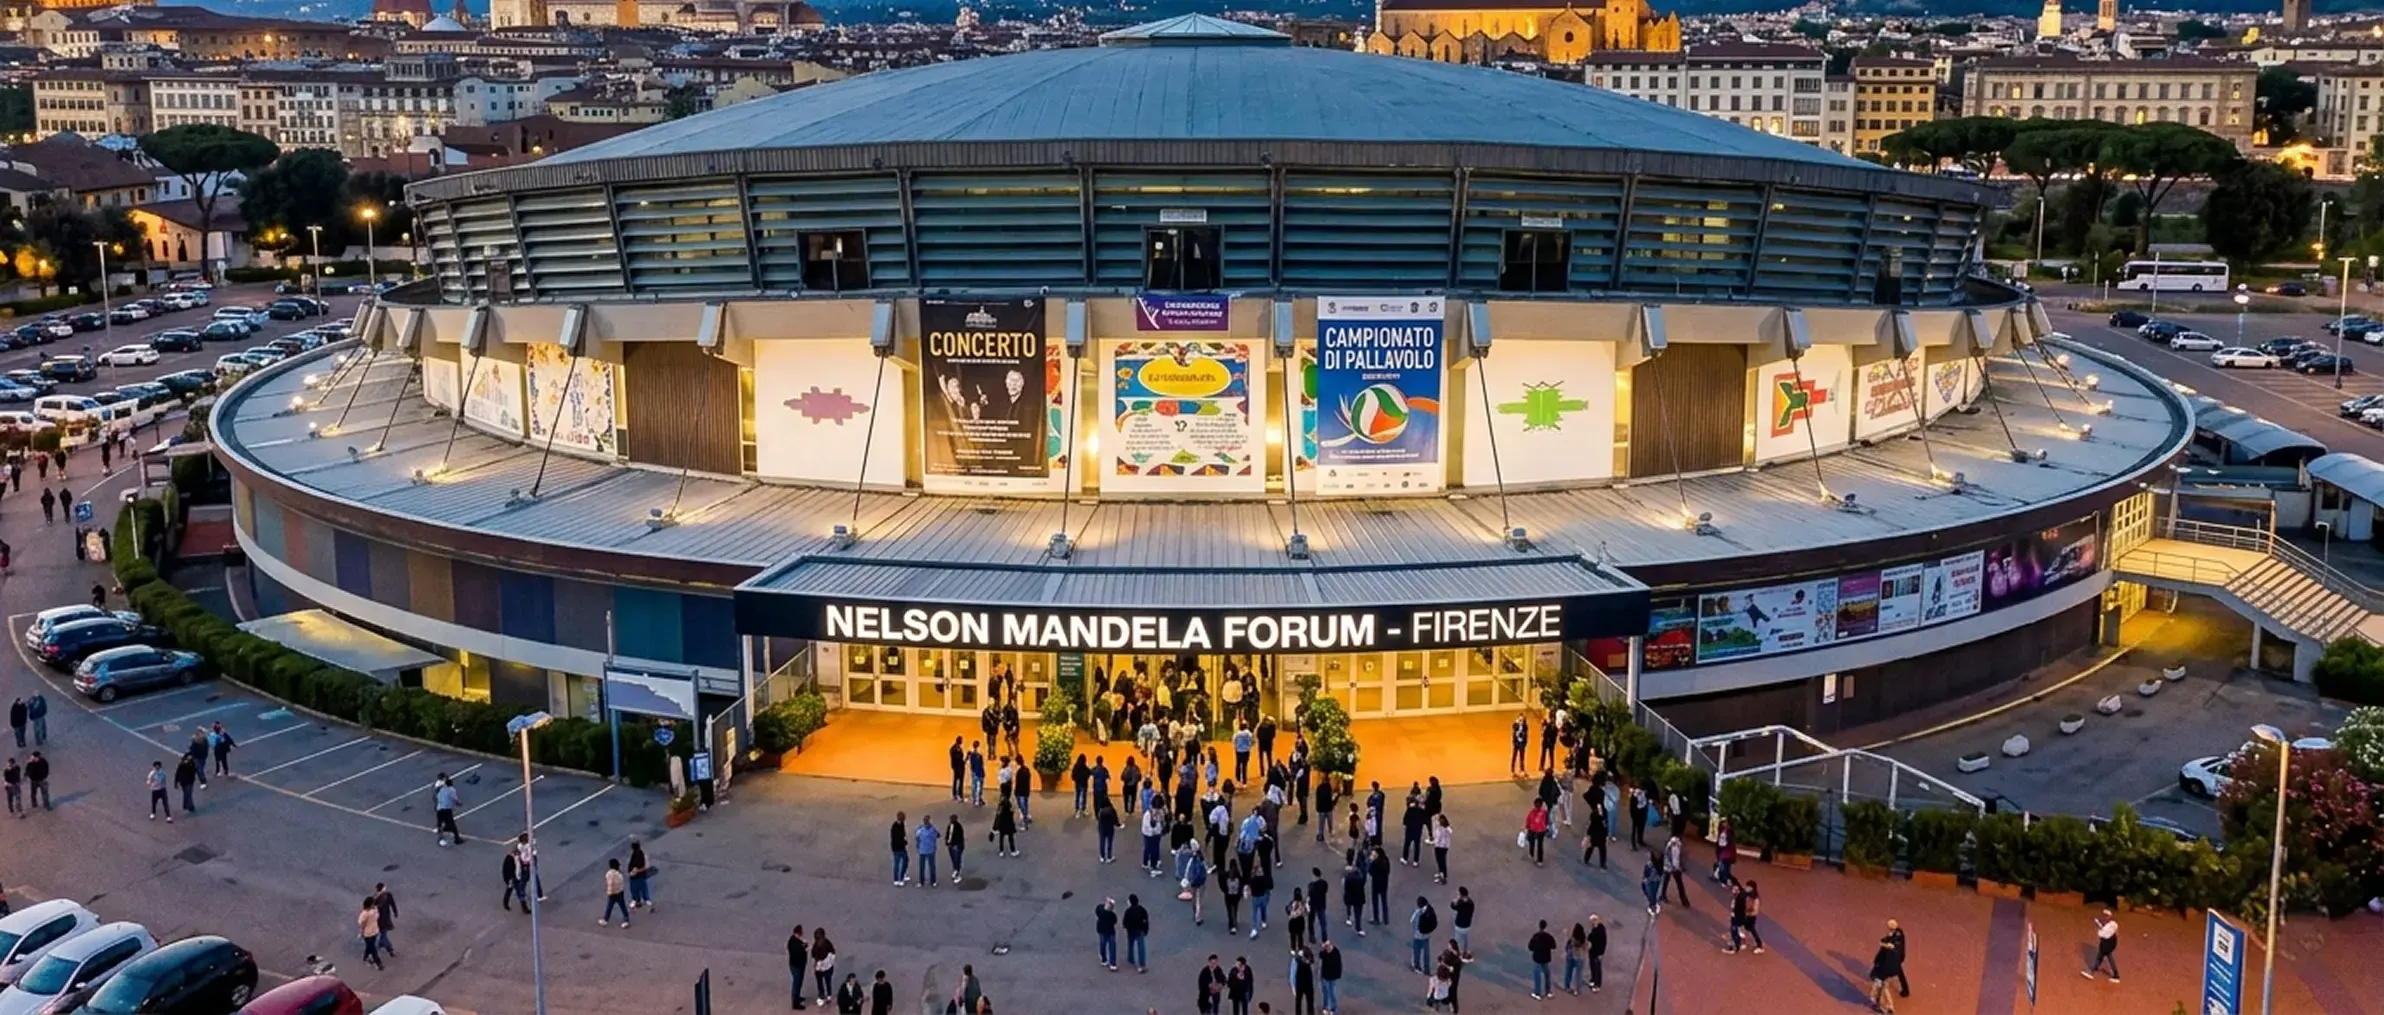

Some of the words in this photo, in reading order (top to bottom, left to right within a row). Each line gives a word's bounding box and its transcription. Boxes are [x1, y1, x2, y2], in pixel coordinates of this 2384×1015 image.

[930, 332, 1036, 358] CONCERTO
[1325, 326, 1434, 348] CAMPIONATO
[1324, 350, 1341, 370] DI
[1345, 349, 1434, 370] PALLAVOLO
[825, 604, 990, 645] NELSON
[1003, 613, 1212, 649] MANDELA
[1224, 614, 1375, 649] FORUM
[1412, 604, 1562, 643] FIRENZE
